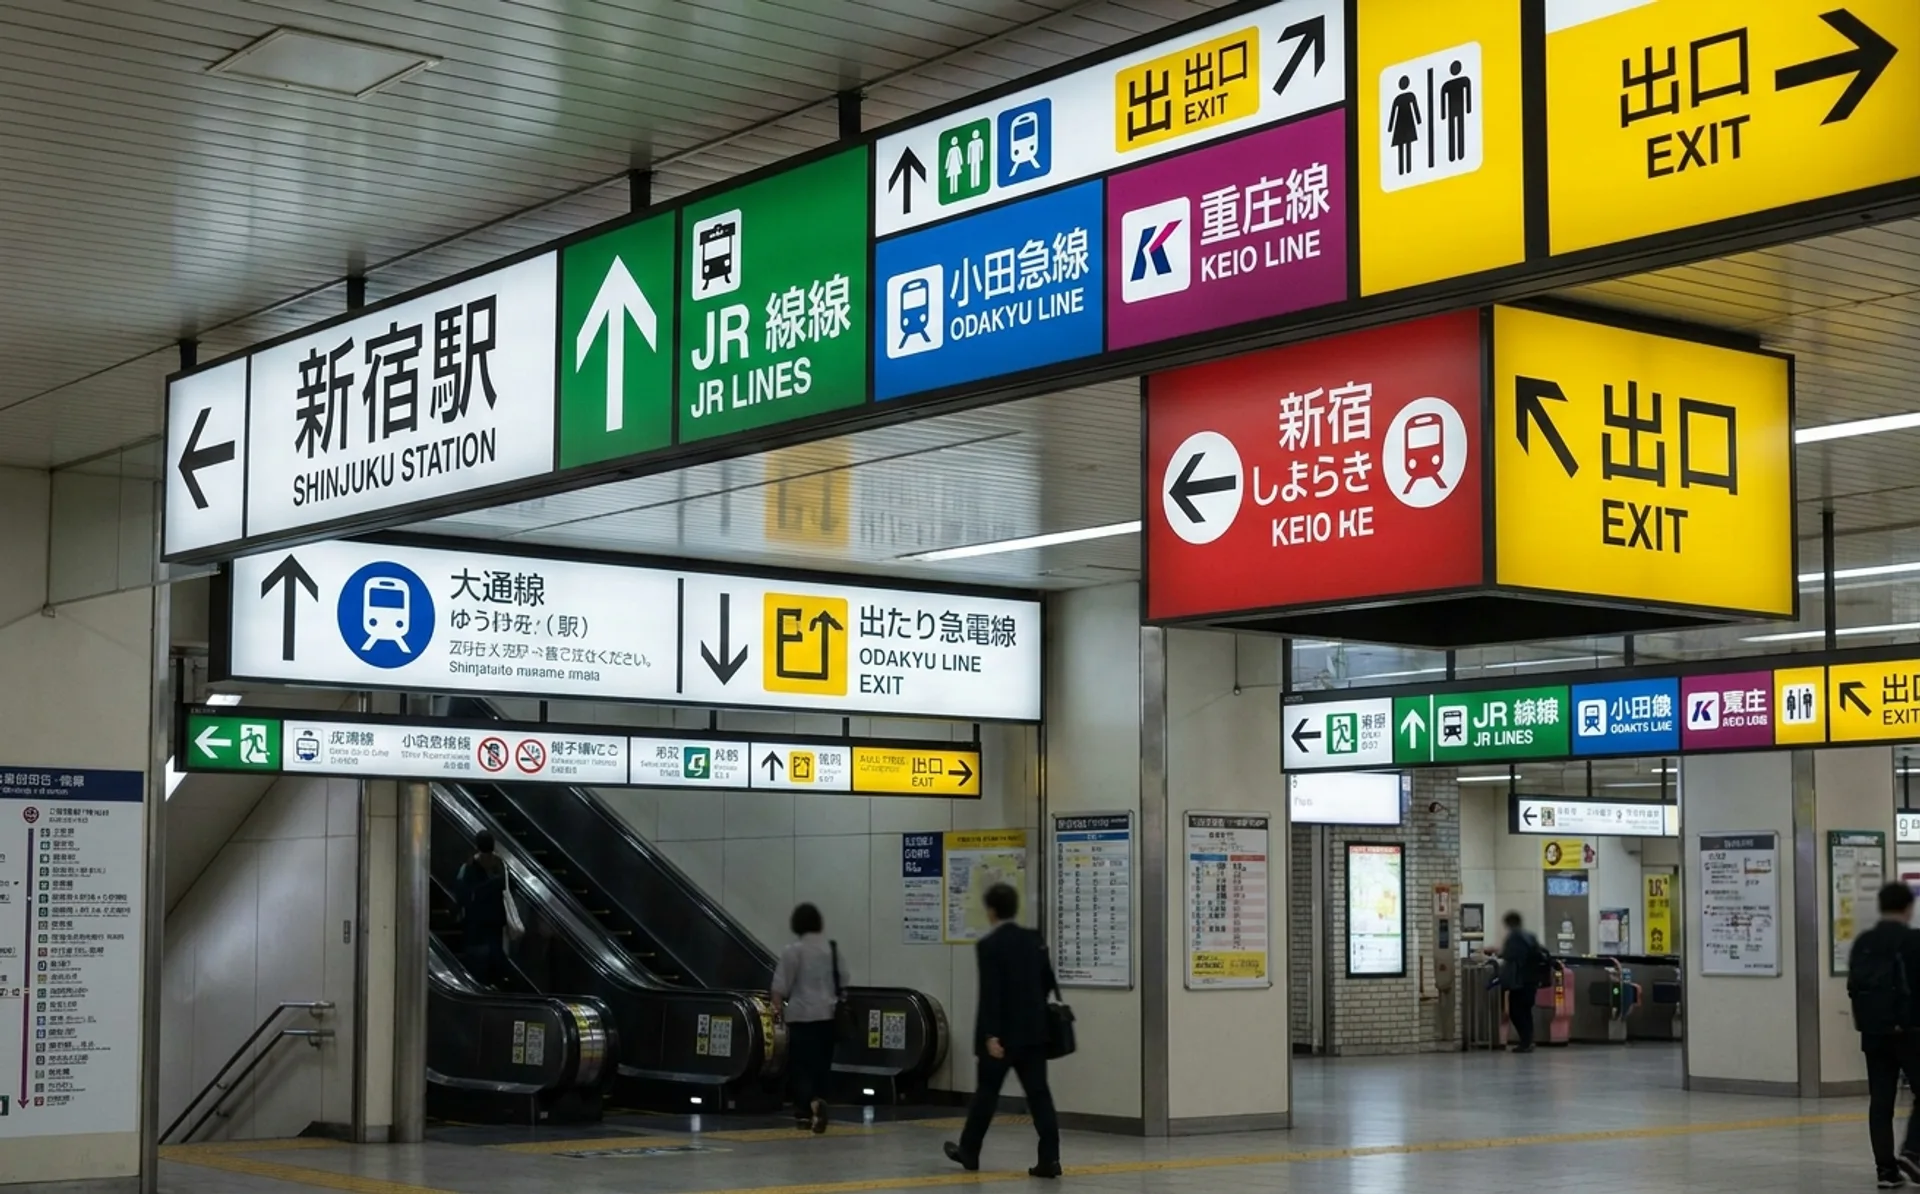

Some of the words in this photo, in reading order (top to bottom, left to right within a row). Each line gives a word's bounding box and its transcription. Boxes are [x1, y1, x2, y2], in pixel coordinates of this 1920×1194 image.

[1184, 40, 1248, 97] 出口
[1619, 27, 1750, 128] 出口
[1127, 69, 1172, 142] 出
[1184, 92, 1229, 125] EXIT
[1646, 114, 1751, 179] EXIT
[1200, 162, 1330, 246] 重庄線
[949, 227, 1090, 308] 小田急線
[1201, 245, 1258, 283] KEIO
[1265, 229, 1321, 268] LINE
[691, 304, 750, 371] JR
[765, 274, 852, 354] 線線
[950, 305, 1033, 341] ODAKYU
[1038, 287, 1084, 320] LINE
[294, 294, 498, 460] 新宿駅
[690, 378, 724, 419] JR
[732, 356, 812, 409] LINES
[1279, 380, 1373, 452] 新宿
[1602, 380, 1738, 496] 出口
[293, 452, 395, 507] SHINJUKU
[401, 427, 496, 483] STATION
[1272, 512, 1332, 548] KEIO
[1602, 499, 1689, 554] EXIT
[450, 567, 545, 607] 大通線
[859, 604, 1017, 648] 出たり急電線
[859, 648, 937, 670] ODAKYU
[942, 654, 982, 673] LINE
[859, 674, 904, 696] EXIT
[1473, 701, 1507, 729] JR
[1473, 732, 1493, 748] JR
[1495, 729, 1534, 746] LINES
[1883, 707, 1920, 726] EXIT
